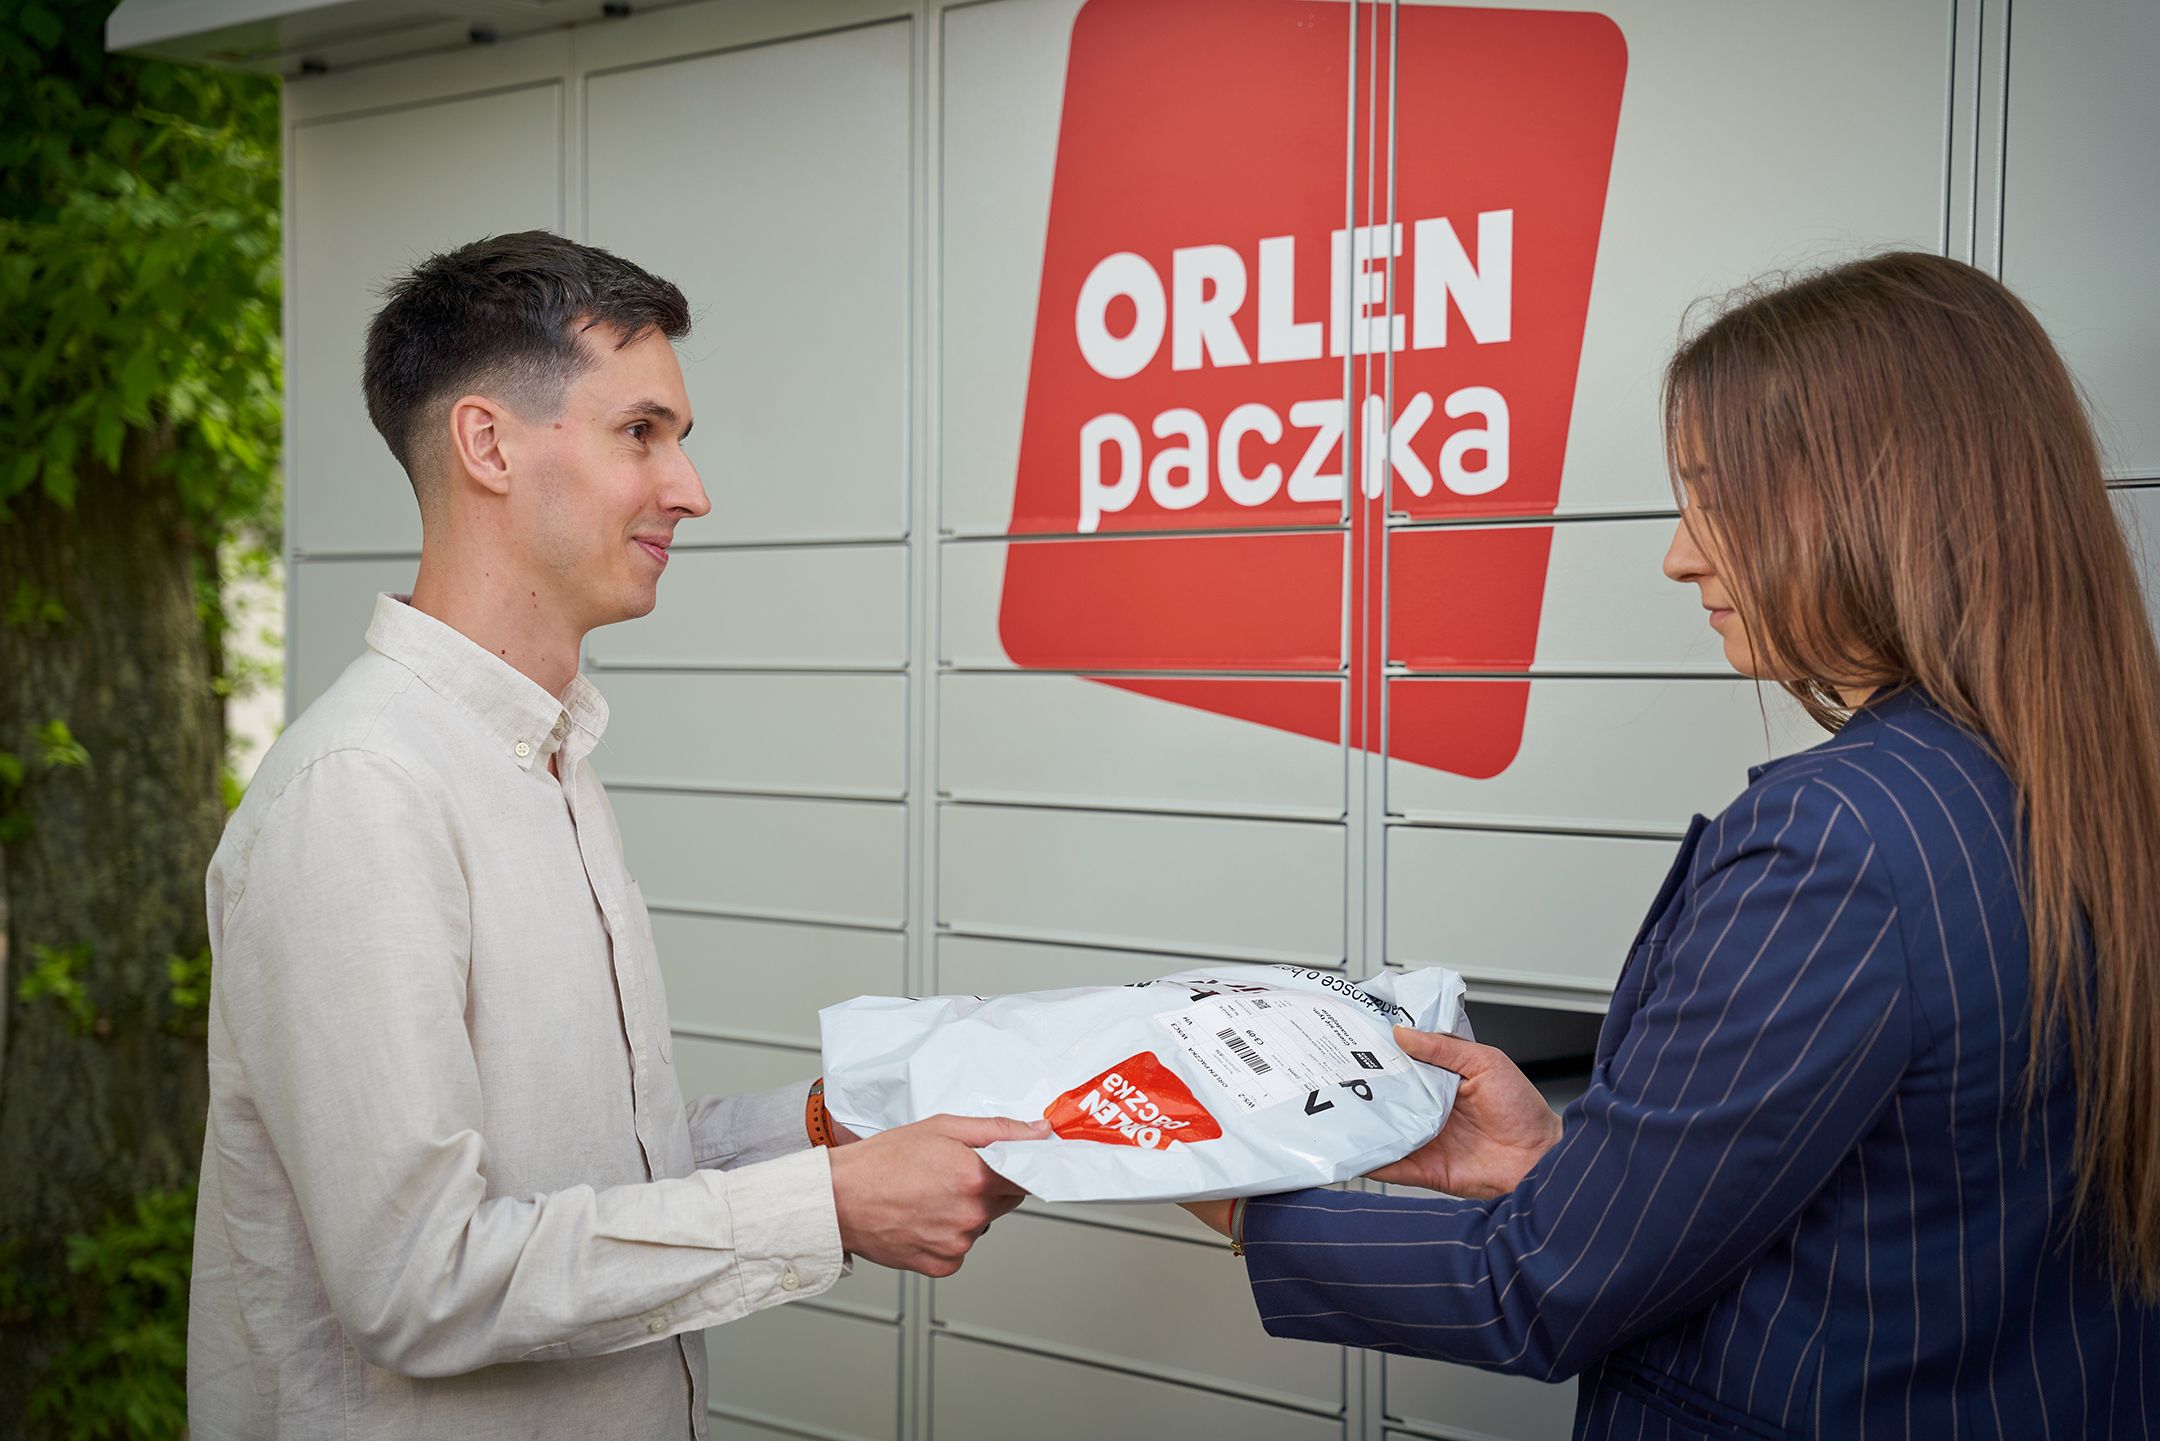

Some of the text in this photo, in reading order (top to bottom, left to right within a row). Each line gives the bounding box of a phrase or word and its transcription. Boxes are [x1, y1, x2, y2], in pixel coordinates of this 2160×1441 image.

[1075, 209, 1513, 379] ORLEN
[1078, 386, 1510, 533] paczka
[1188, 1047, 1209, 1069] PACZKA
[1246, 1029, 1264, 1045] C3-09
[1102, 1073, 1190, 1129] paczka
[1208, 1068, 1228, 1088] ORLEN
[1078, 1089, 1161, 1149] ORLEN
